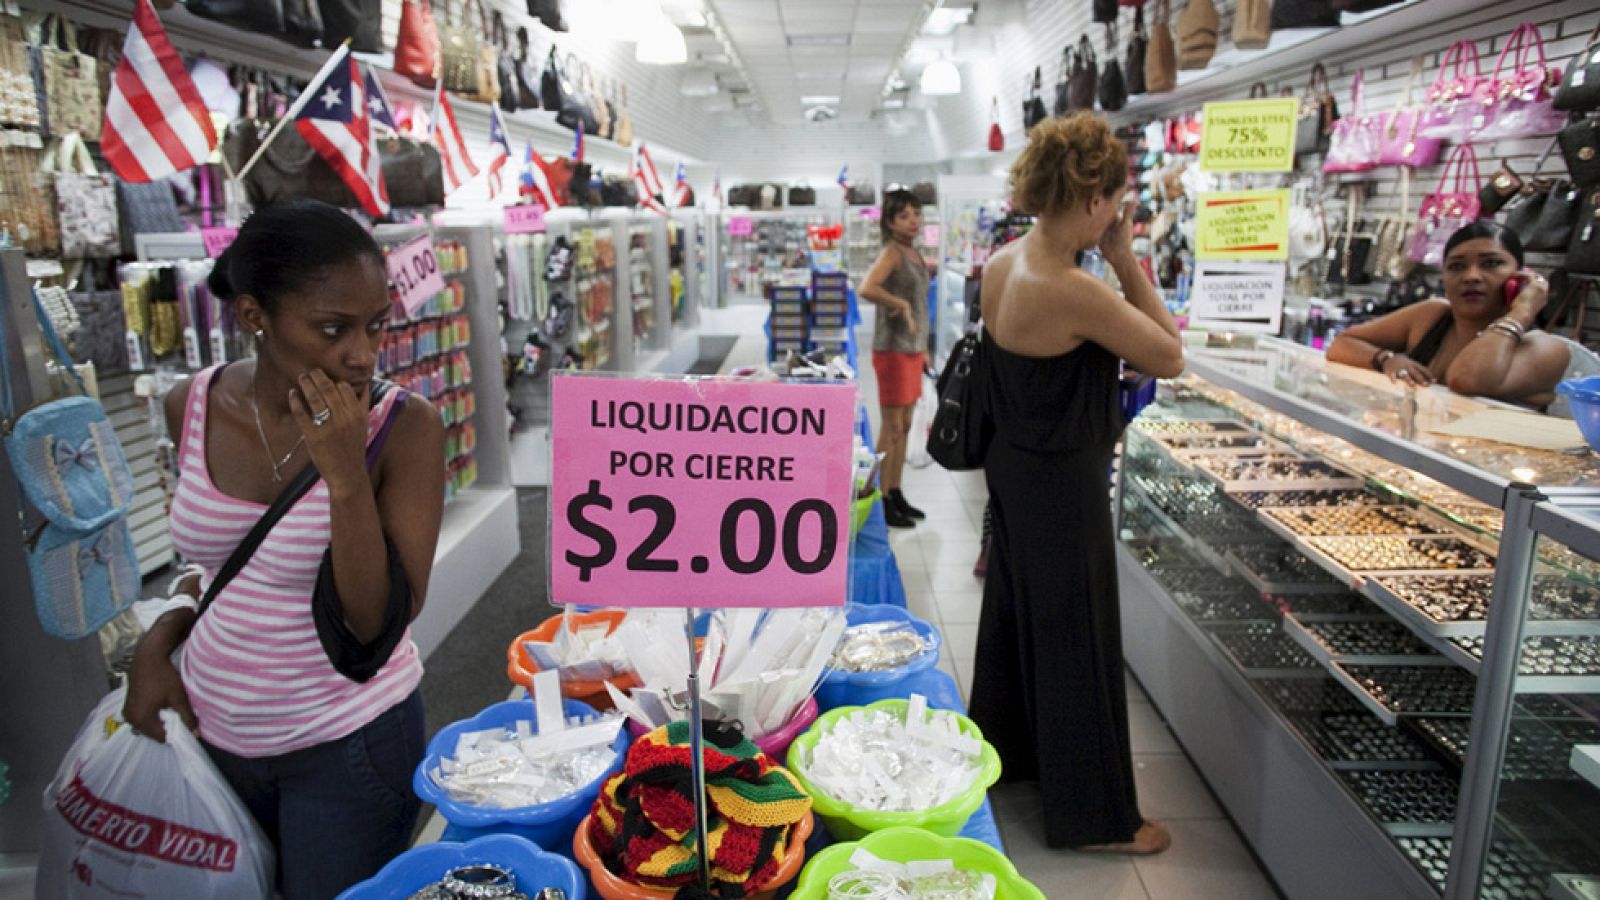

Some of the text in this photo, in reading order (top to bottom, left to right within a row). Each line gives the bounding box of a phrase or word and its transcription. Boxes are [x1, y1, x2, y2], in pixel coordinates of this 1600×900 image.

[1208, 113, 1290, 128] STAINLESS STEEL
[1228, 127, 1268, 145] 75%
[1207, 146, 1285, 159] DESCUENTO
[1226, 205, 1258, 215] VENTA
[1208, 213, 1275, 227] LIQUIDACION
[1216, 223, 1269, 236] TOTAL POR
[1225, 235, 1258, 245] CIERRE
[395, 248, 436, 296] $1.00
[1202, 281, 1273, 291] LIQUIDACION
[1208, 292, 1265, 301] TOTAL POR
[1217, 304, 1254, 313] CIERRE
[591, 399, 825, 436] LIQUIDACION
[609, 450, 795, 481] POR CIERRE
[565, 479, 838, 582] $2.00
[58, 785, 152, 848] UMERTO
[159, 828, 234, 869] VIDAL
